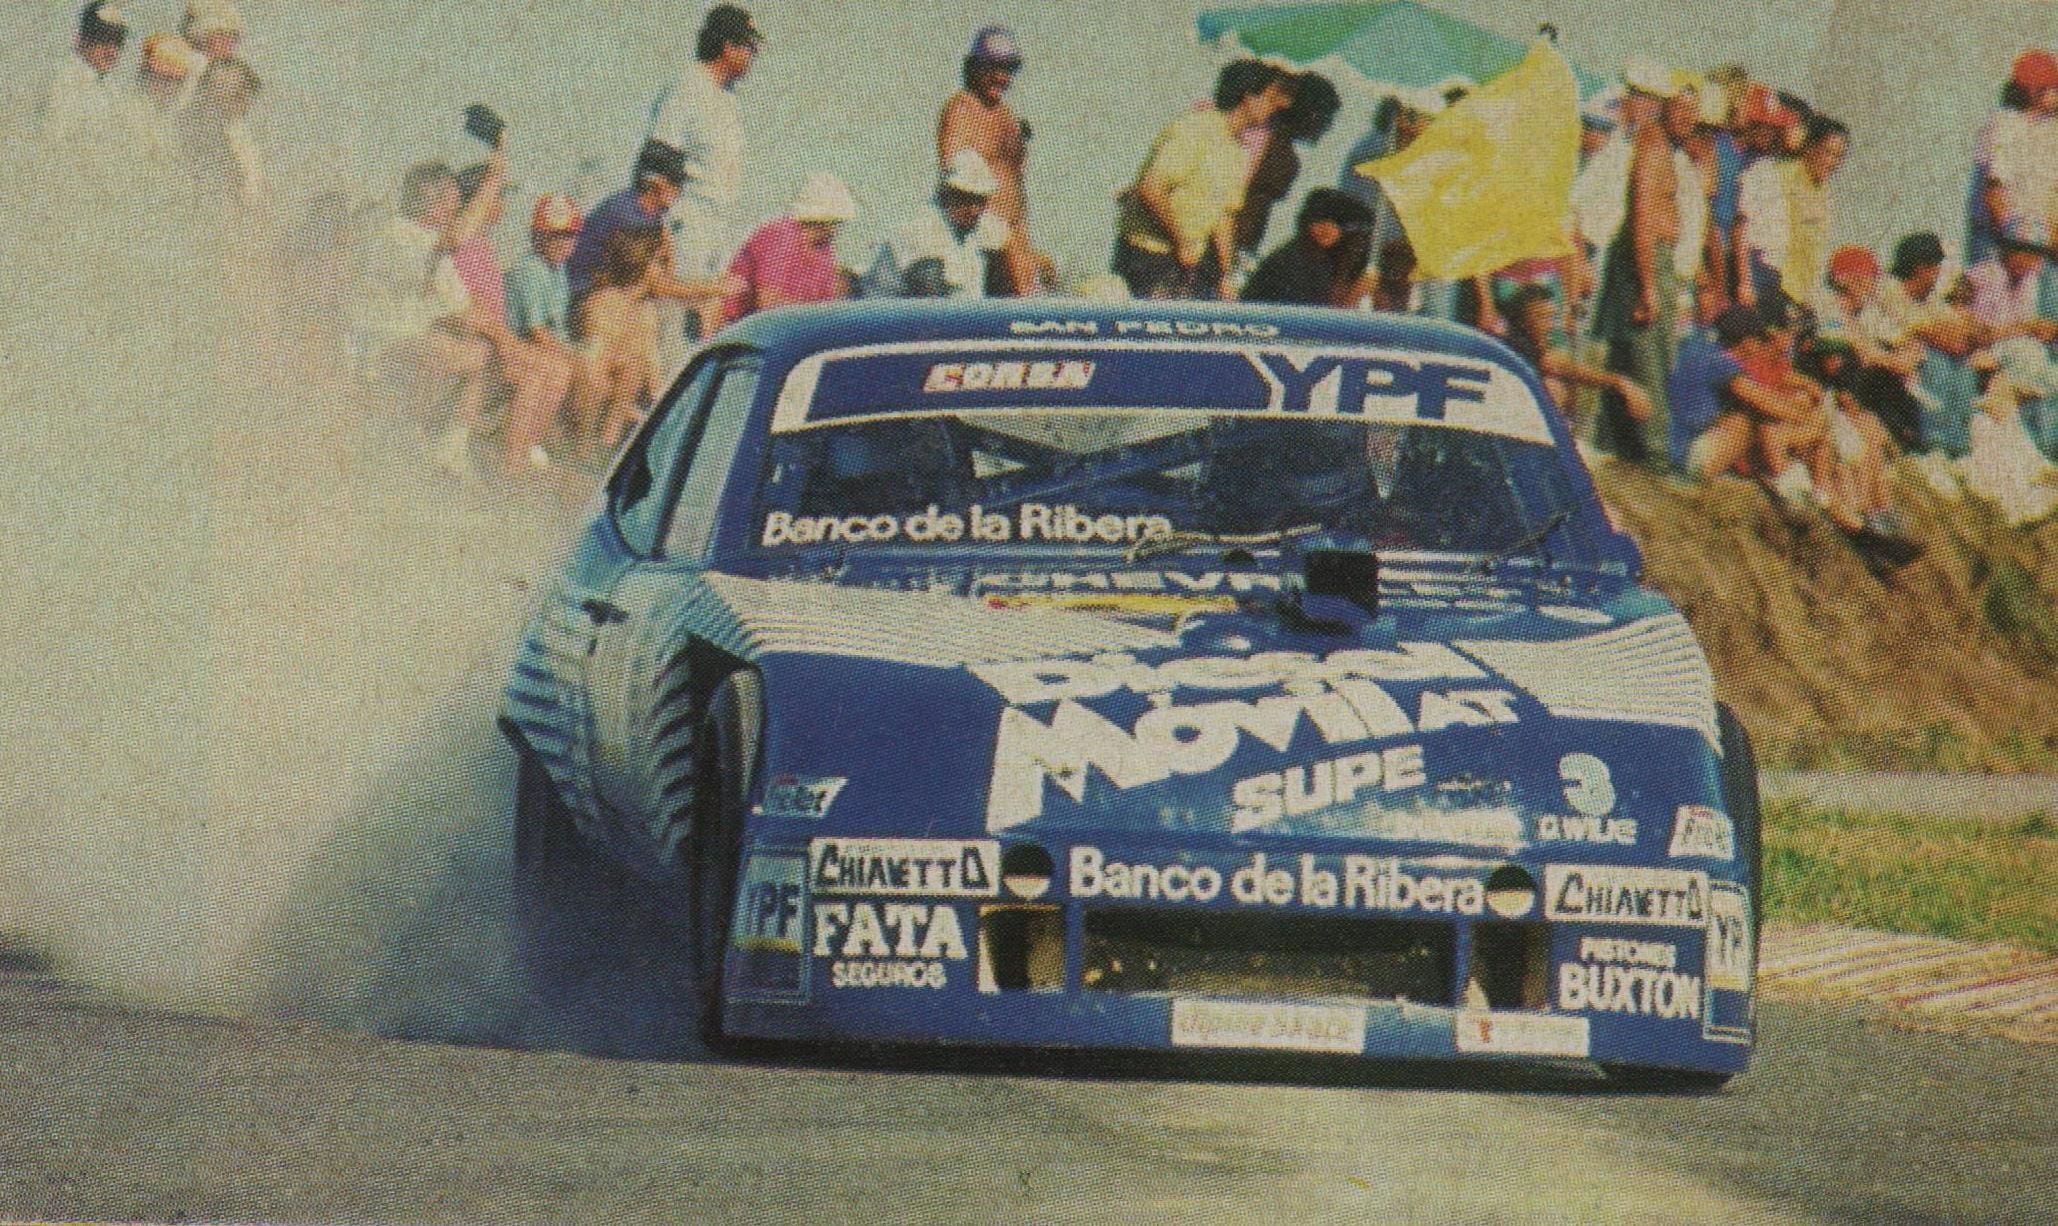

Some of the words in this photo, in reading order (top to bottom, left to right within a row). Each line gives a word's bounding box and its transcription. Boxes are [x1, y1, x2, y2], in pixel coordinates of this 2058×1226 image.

[1008, 320, 1098, 336] SAN
[1114, 321, 1278, 338] PEDRO
[1258, 350, 1492, 421] YPF
[762, 510, 898, 546] Banco
[905, 503, 965, 541] de
[970, 503, 1010, 541] la
[1019, 502, 1172, 542] Ribera
[1558, 752, 1617, 817] 3
[1068, 846, 1222, 901] Banco
[1231, 853, 1296, 905] de
[1299, 853, 1339, 907] la
[1343, 855, 1487, 916] Ribera
[813, 903, 969, 960] FATA
[832, 961, 948, 990] SEGUROS
[1559, 962, 1700, 1020] BUXTON
